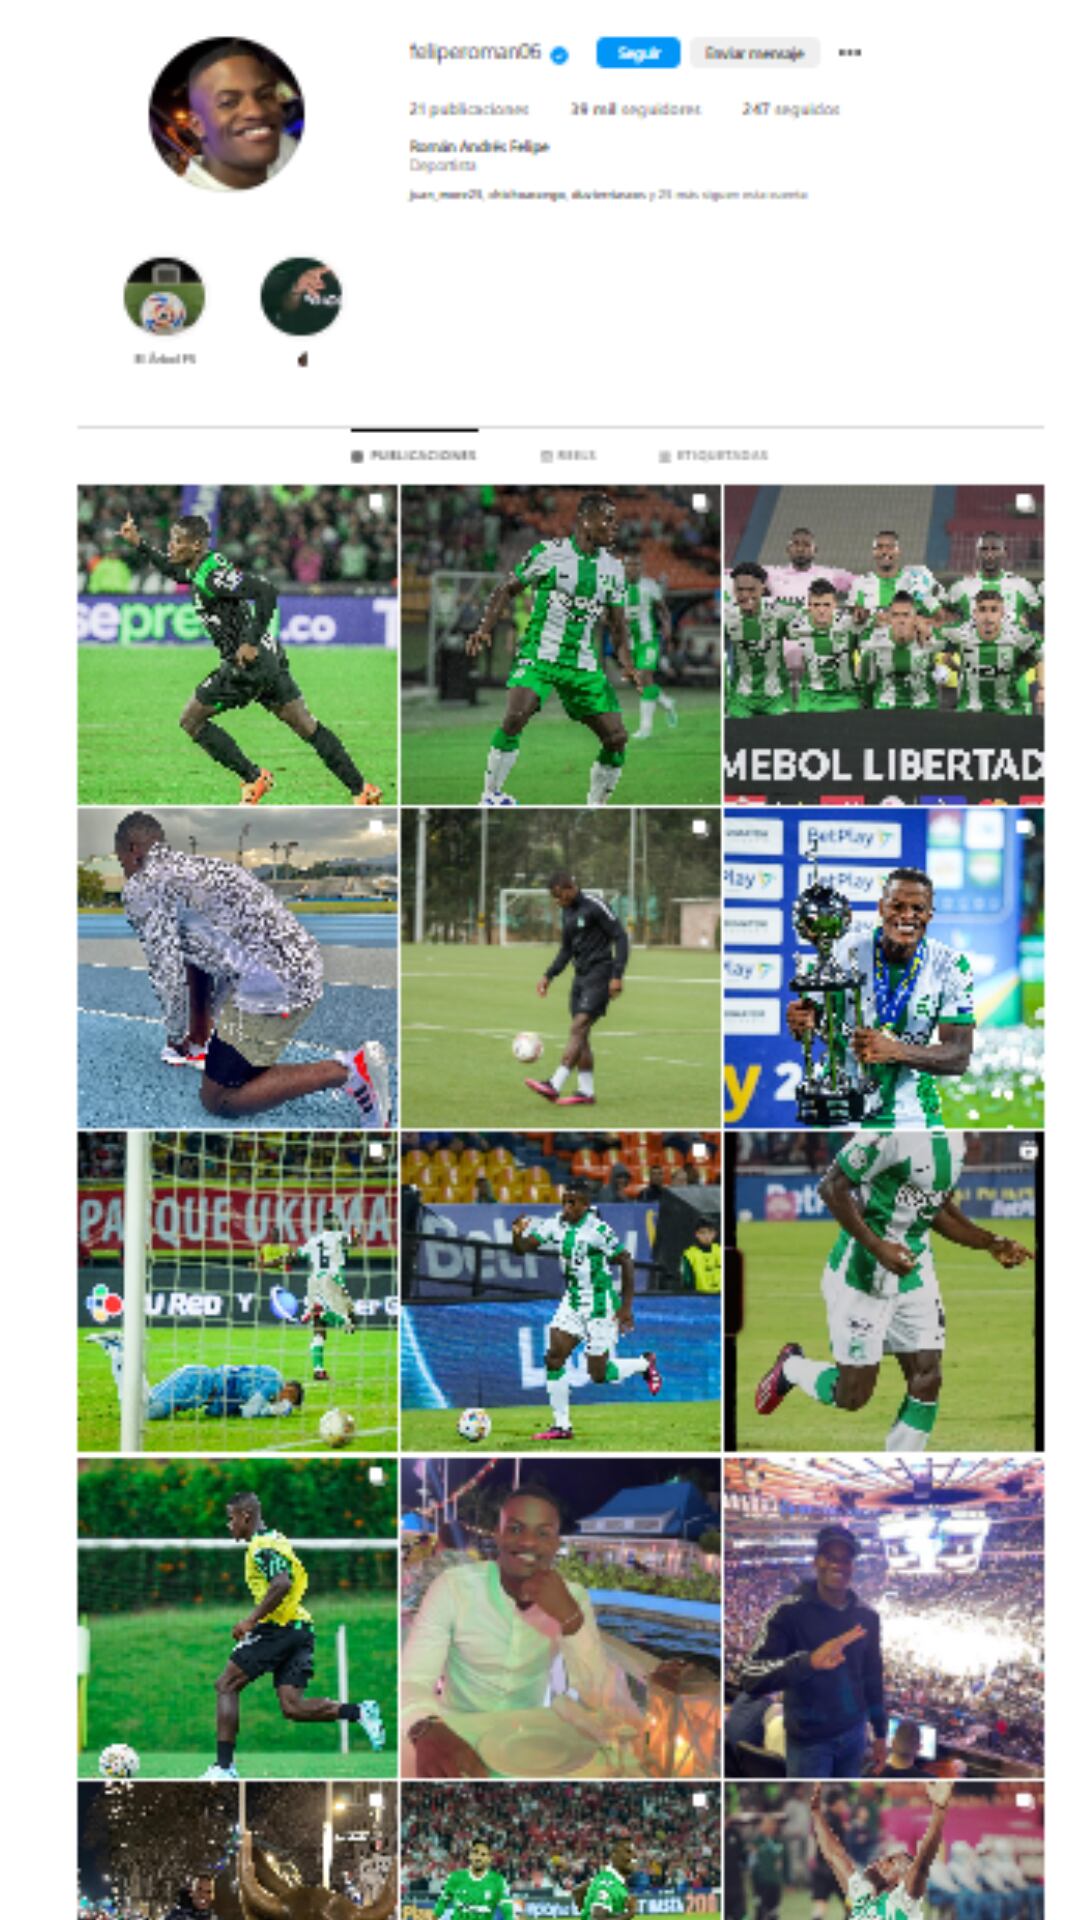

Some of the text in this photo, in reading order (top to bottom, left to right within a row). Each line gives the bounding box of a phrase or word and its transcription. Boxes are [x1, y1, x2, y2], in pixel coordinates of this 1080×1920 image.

[409, 42, 542, 65] feliperoman06
[616, 45, 662, 62] Seguir
[705, 45, 806, 63] Enviar mensaje
[429, 101, 529, 118] publicaciones
[593, 101, 616, 115] mil
[621, 101, 701, 118] seguidores
[775, 101, 840, 118] seguidos
[409, 138, 550, 155] Román Andrés Felipe
[409, 157, 476, 173] Deportista
[369, 449, 477, 462] PUBLICACIONES
[79, 1197, 232, 1247] PAQUE
